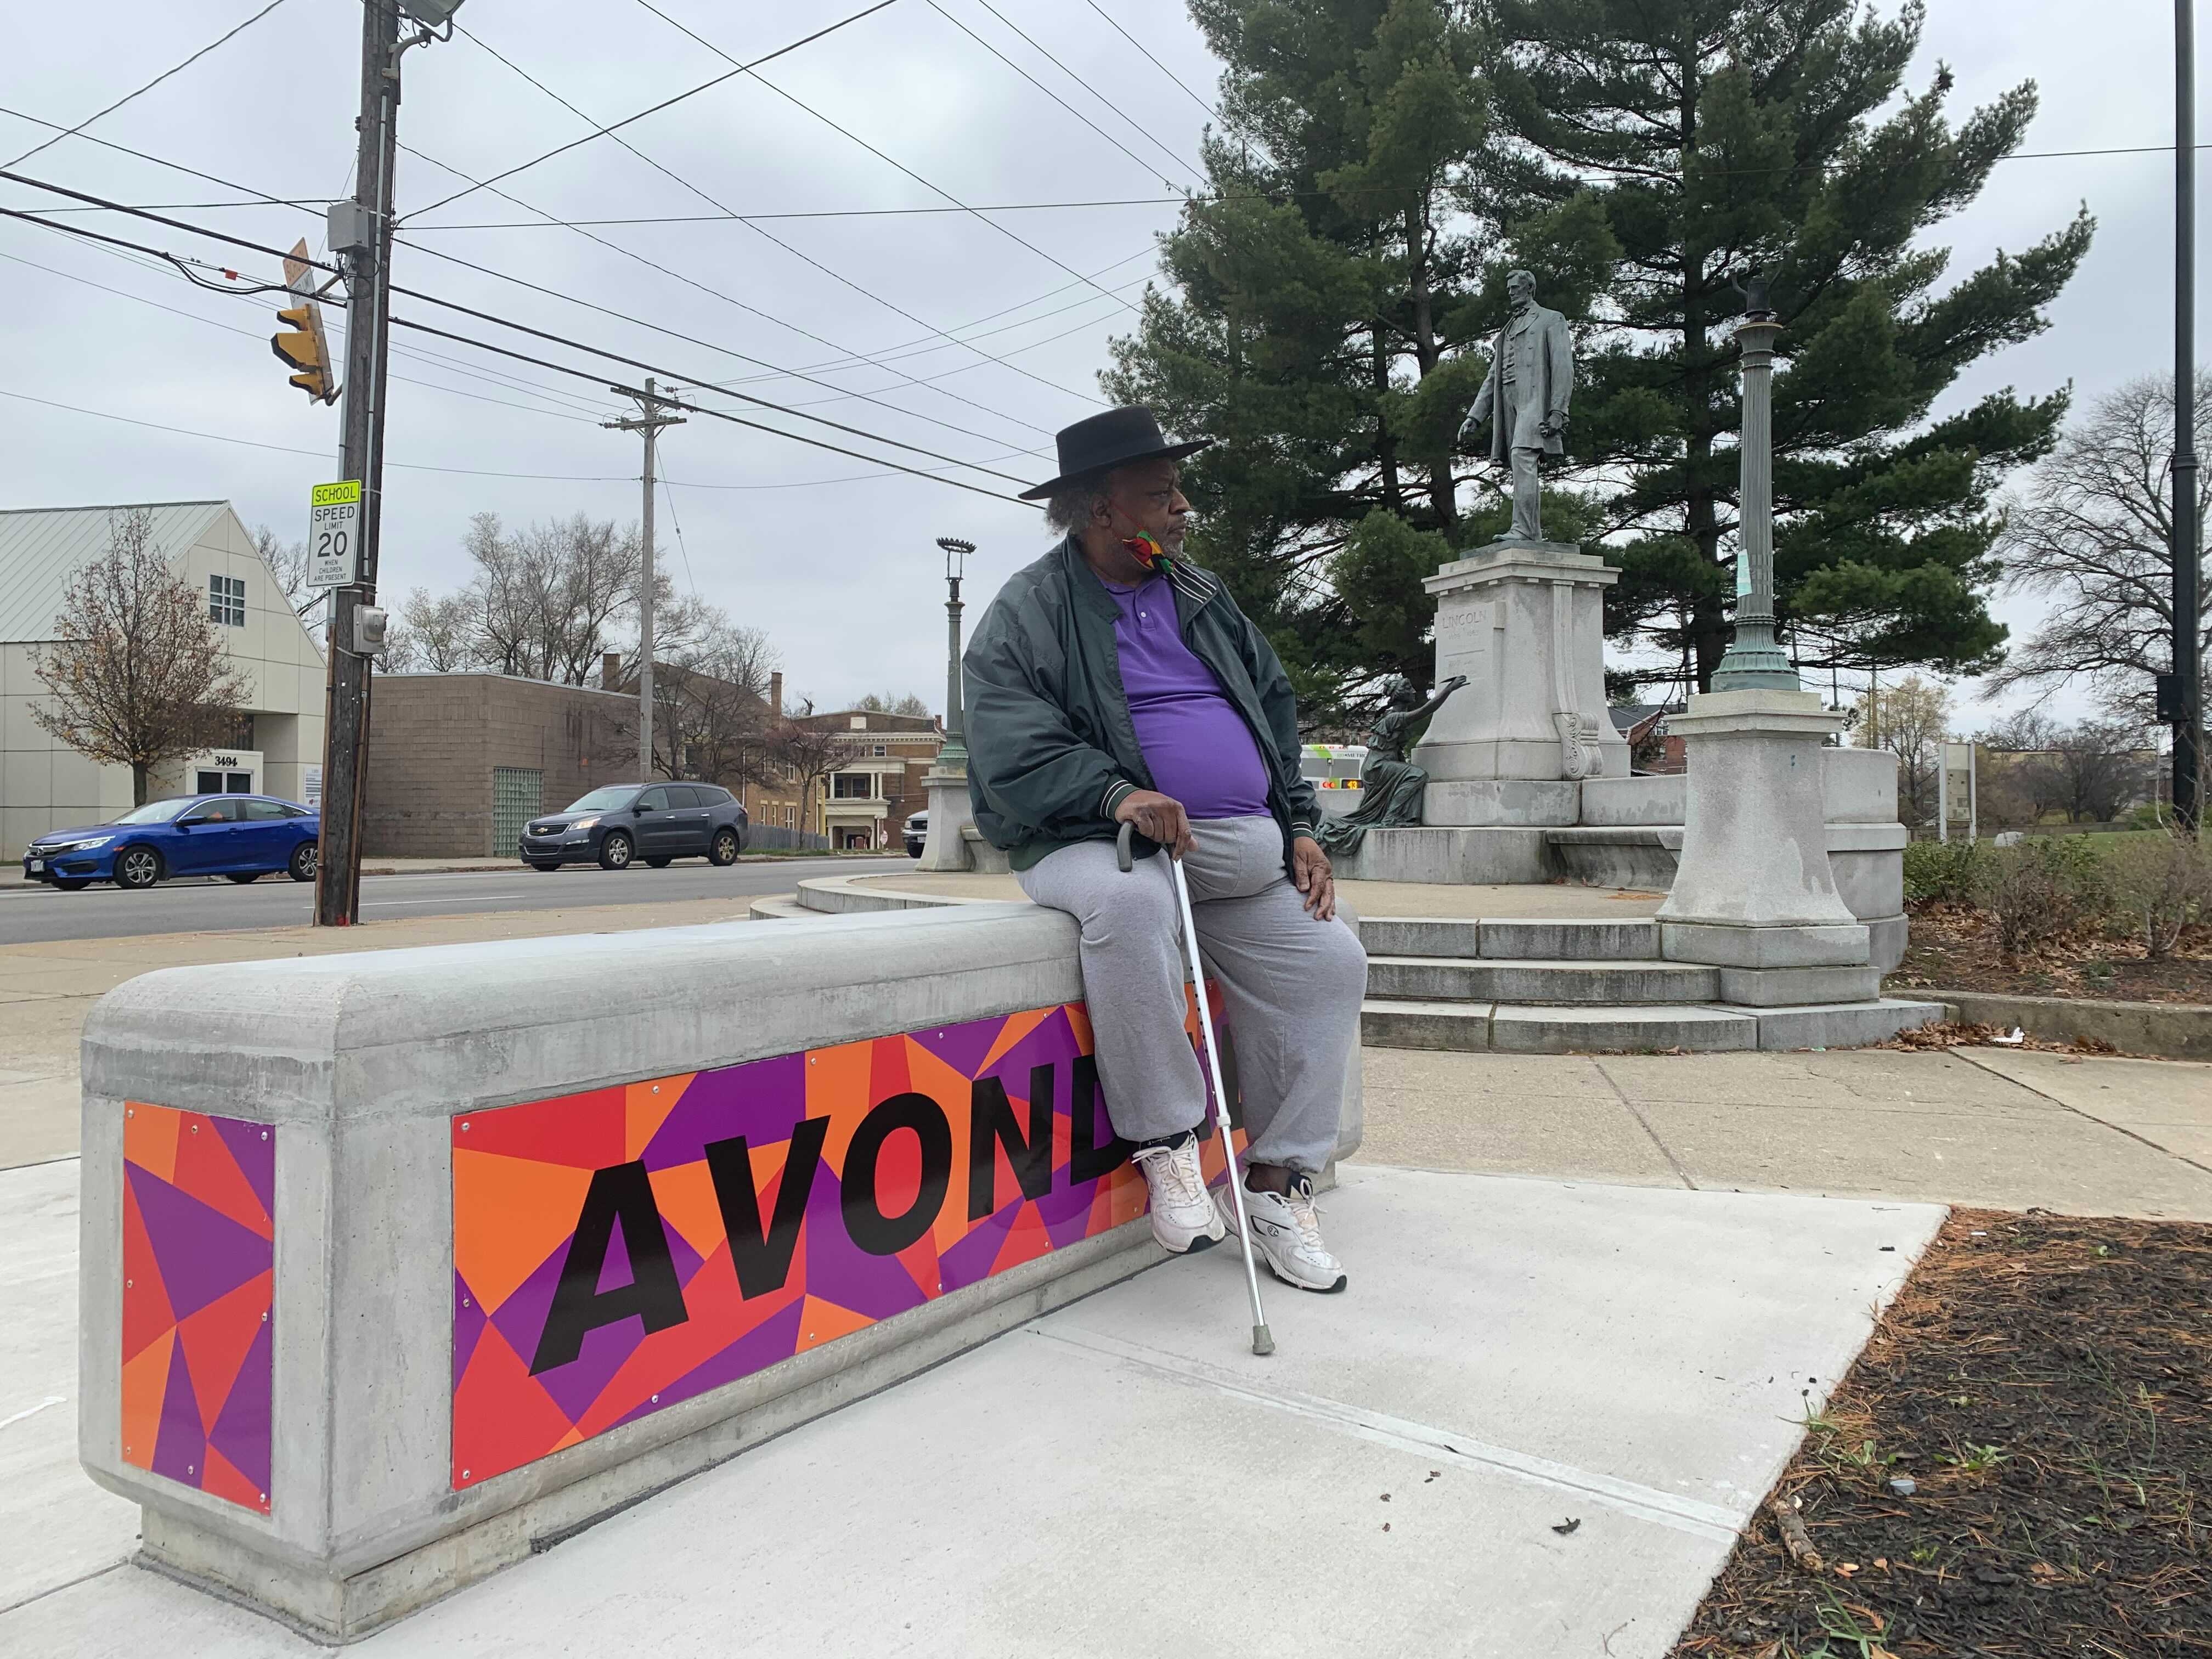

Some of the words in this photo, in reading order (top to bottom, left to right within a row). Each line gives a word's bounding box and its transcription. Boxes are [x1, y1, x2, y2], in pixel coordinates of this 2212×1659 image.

[315, 486, 356, 502] SCHOOL
[314, 506, 355, 522] SPEED
[324, 521, 343, 531] LIMIT
[317, 531, 347, 557] 20
[319, 566, 342, 575] CHILDREN
[325, 573, 347, 582] PRESENT
[1443, 611, 1486, 629] LINCOLN
[215, 756, 238, 767] 3494
[1347, 780, 1357, 790] 43
[528, 1024, 1244, 1378] AVOND
